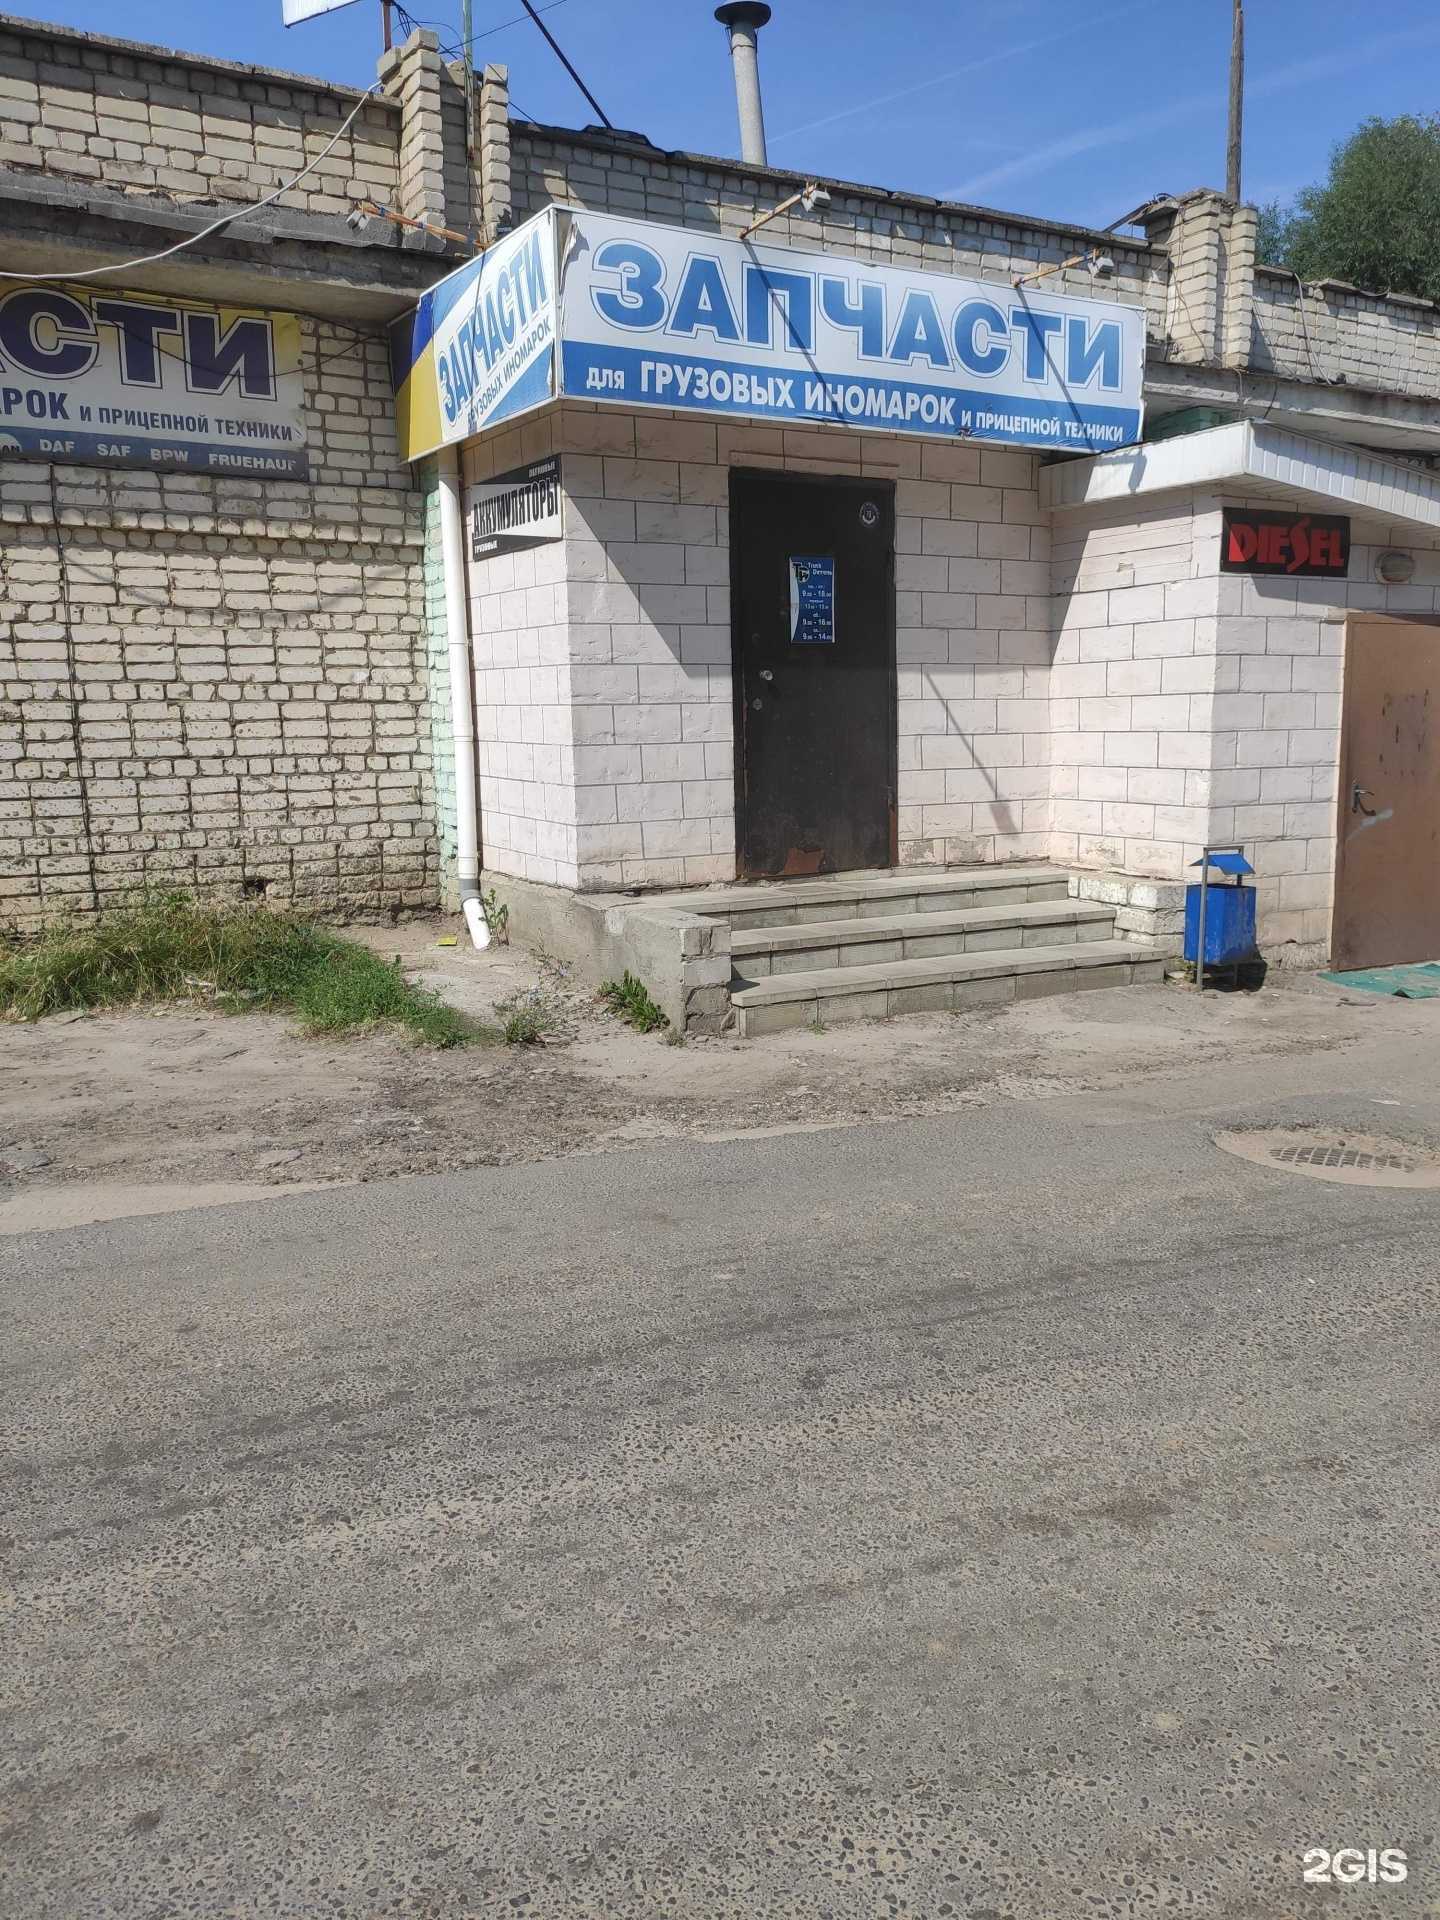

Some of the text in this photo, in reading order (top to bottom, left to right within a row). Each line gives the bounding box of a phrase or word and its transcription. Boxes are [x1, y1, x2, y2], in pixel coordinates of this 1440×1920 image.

[0, 287, 278, 402] СТИ
[439, 226, 552, 427] ЗАПЧАСТИ
[589, 238, 1123, 393] ЗАПЧАСТИ
[503, 316, 552, 384] ИНОМАРОК
[0, 387, 293, 442] РОК И ПРИЦЕПНОЙ ТЕХНИКИ
[640, 361, 796, 409] ГРУЗОВЫХ
[804, 381, 956, 426] ИНОМАРОК
[976, 411, 1061, 436] ПРИЦЕПНОЙ
[1064, 420, 1124, 442] ТЕХНИКИ
[39, 438, 76, 453] DAF
[96, 443, 132, 458] SAF
[150, 448, 189, 463] BPW
[208, 453, 297, 472] FRUEHAUF
[473, 474, 559, 540] АККУМУЛЯТОРЫ
[1228, 517, 1345, 573] DIESEL
